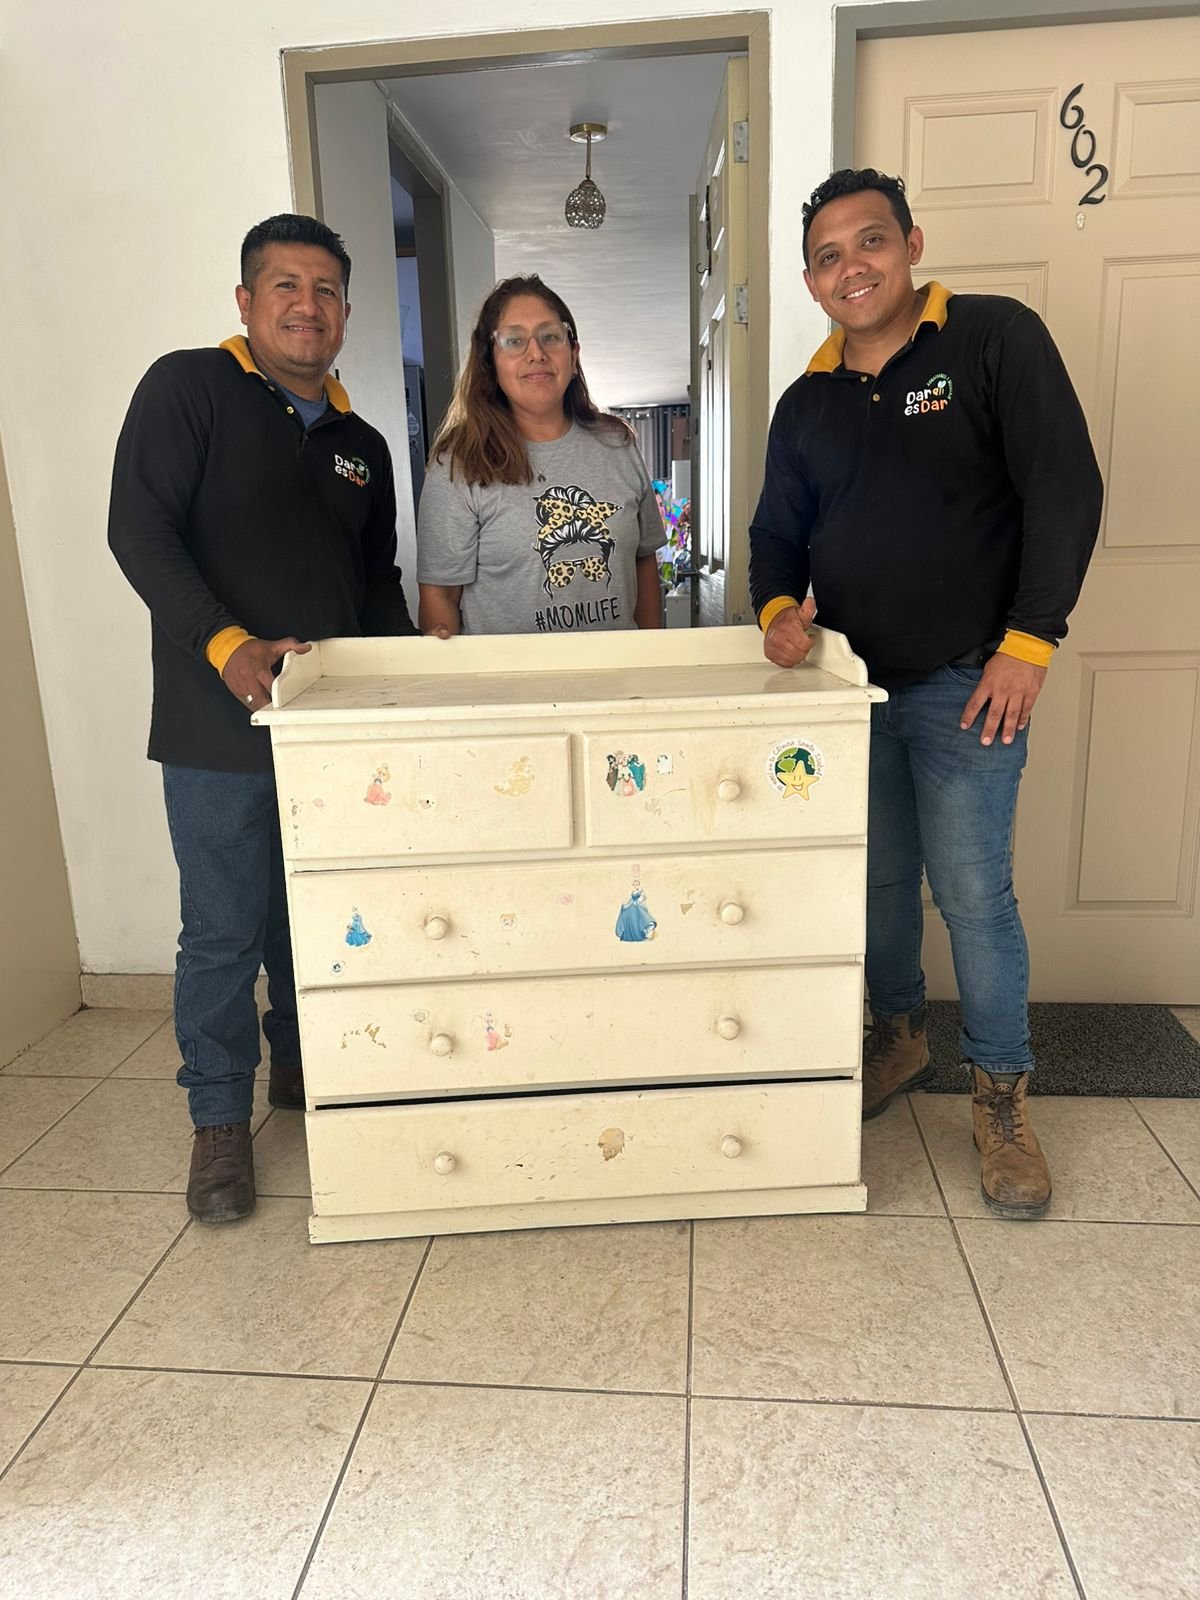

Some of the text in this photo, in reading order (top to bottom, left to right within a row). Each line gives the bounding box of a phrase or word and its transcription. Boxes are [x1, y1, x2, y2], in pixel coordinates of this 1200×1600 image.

[1060, 83, 1109, 206] 602
[906, 389, 931, 405] Dar
[535, 597, 620, 631] #MOMLIFE
